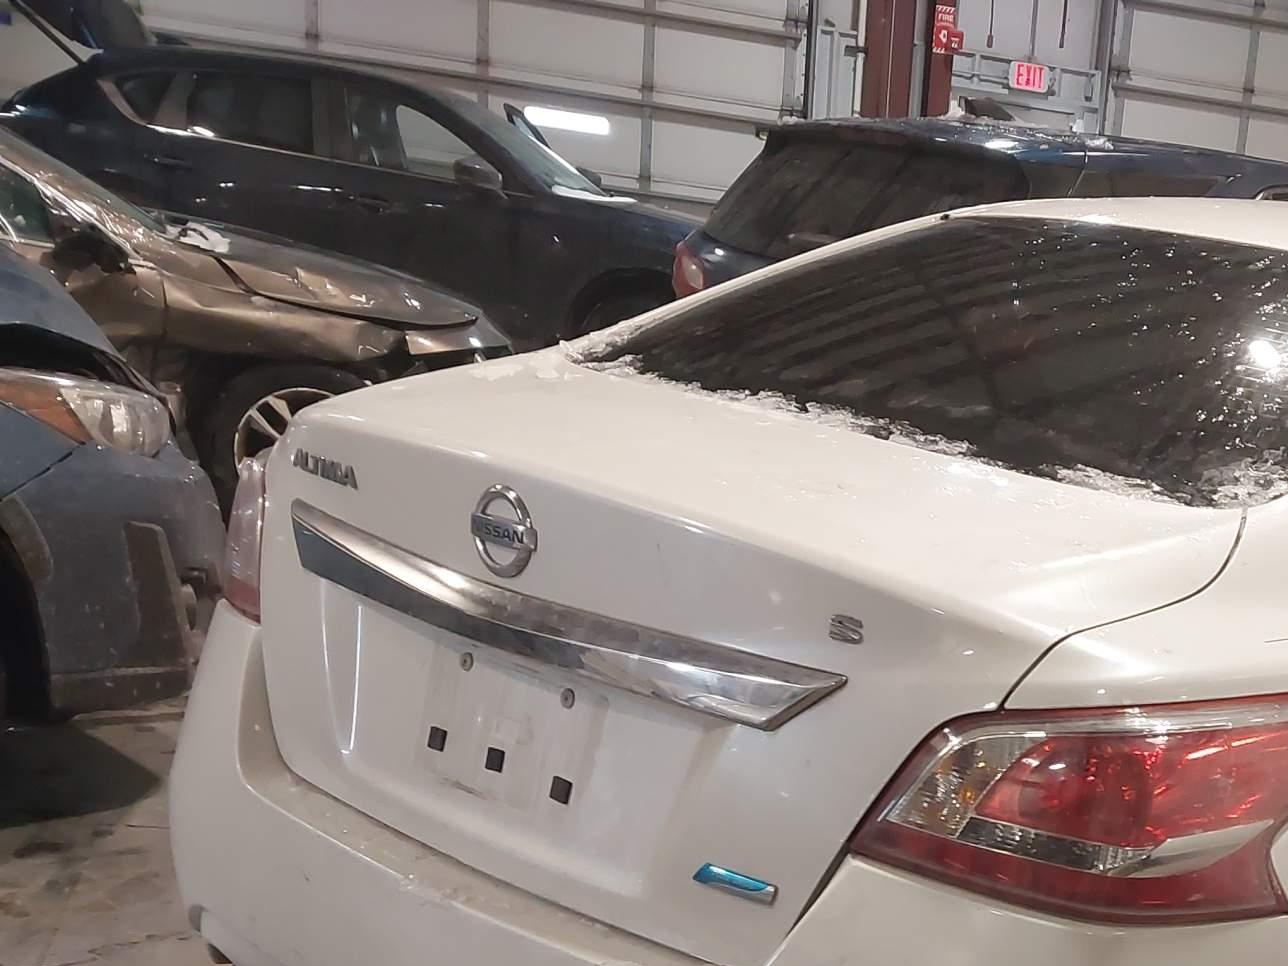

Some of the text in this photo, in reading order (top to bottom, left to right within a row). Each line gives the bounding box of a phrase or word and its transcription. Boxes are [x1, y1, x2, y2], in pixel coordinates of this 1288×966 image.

[1016, 63, 1044, 89] EXIT
[292, 448, 358, 490] ALTIMA
[828, 614, 864, 644] S
